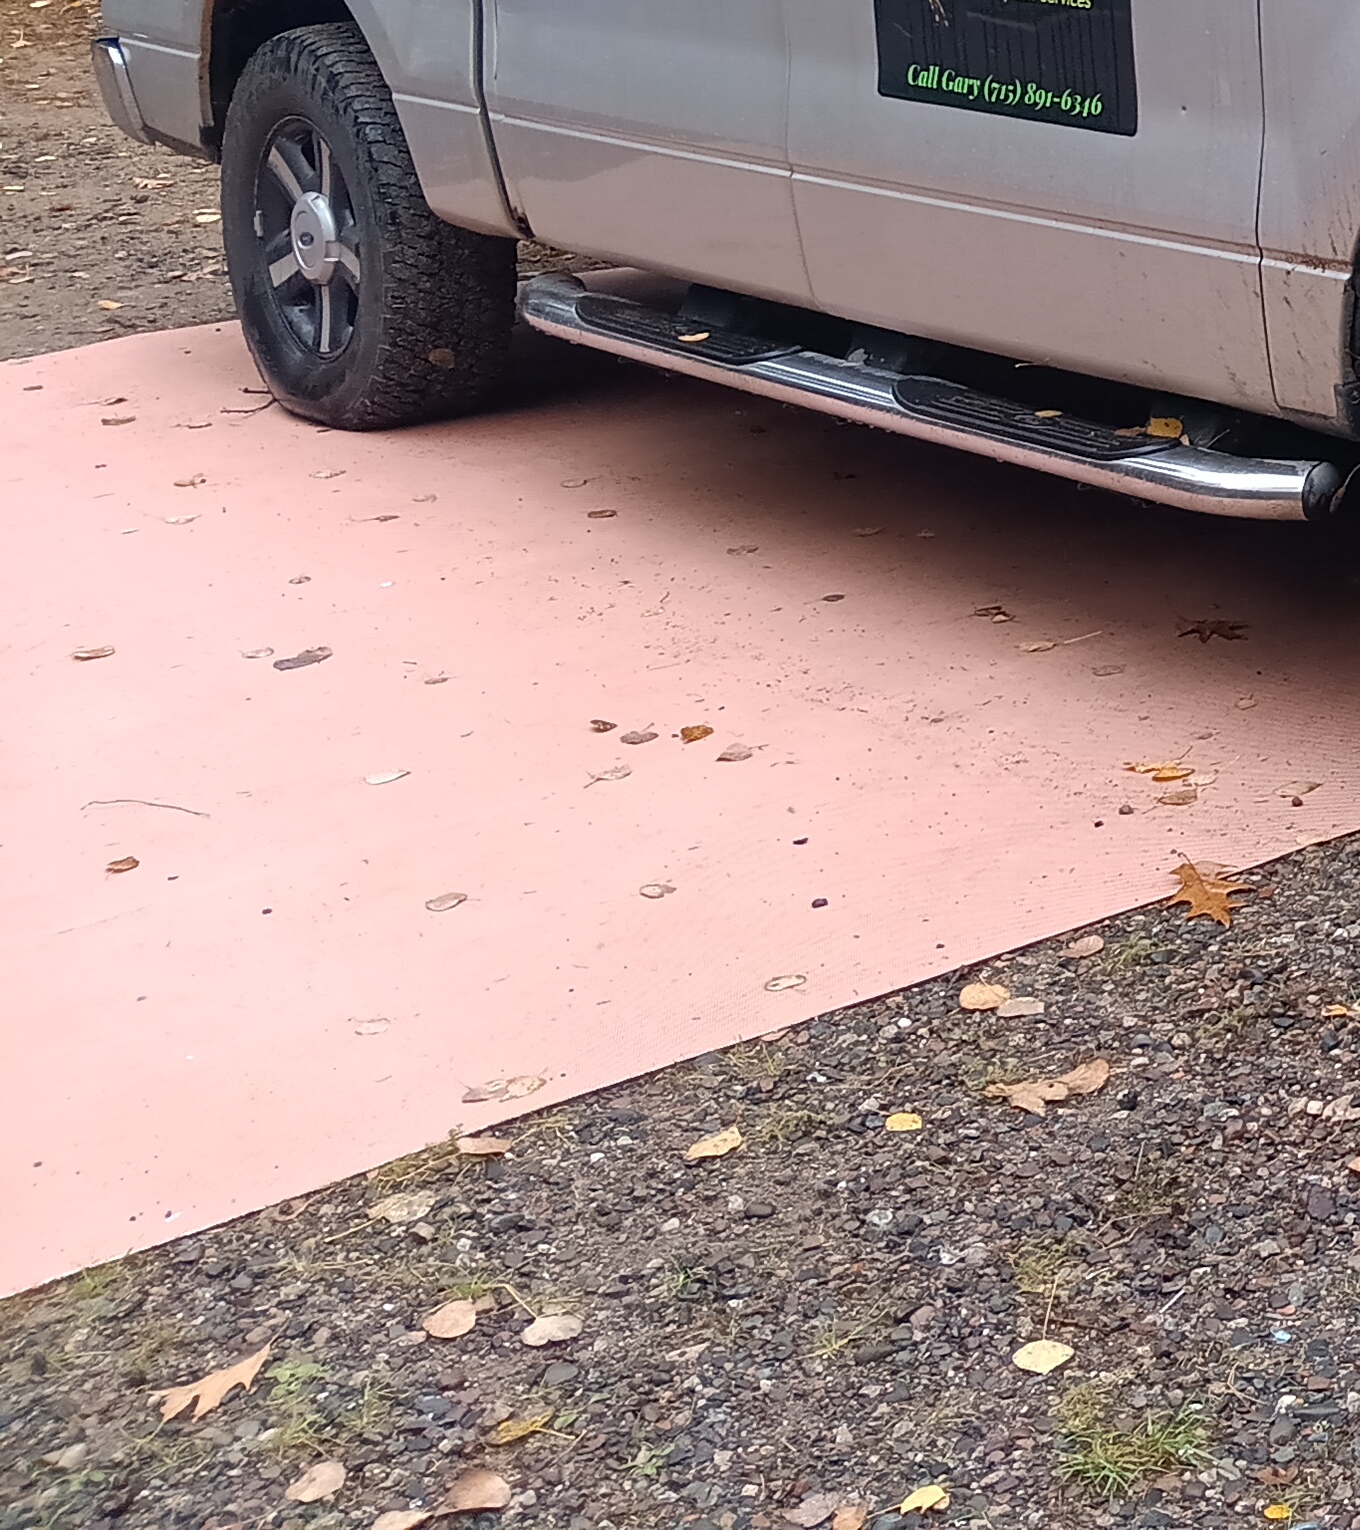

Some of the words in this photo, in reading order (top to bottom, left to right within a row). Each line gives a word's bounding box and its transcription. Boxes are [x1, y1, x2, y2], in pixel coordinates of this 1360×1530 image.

[906, 64, 939, 90] Call
[941, 70, 981, 100] Gary
[983, 74, 1022, 106] (715)
[1024, 83, 1103, 117] 891-6346
